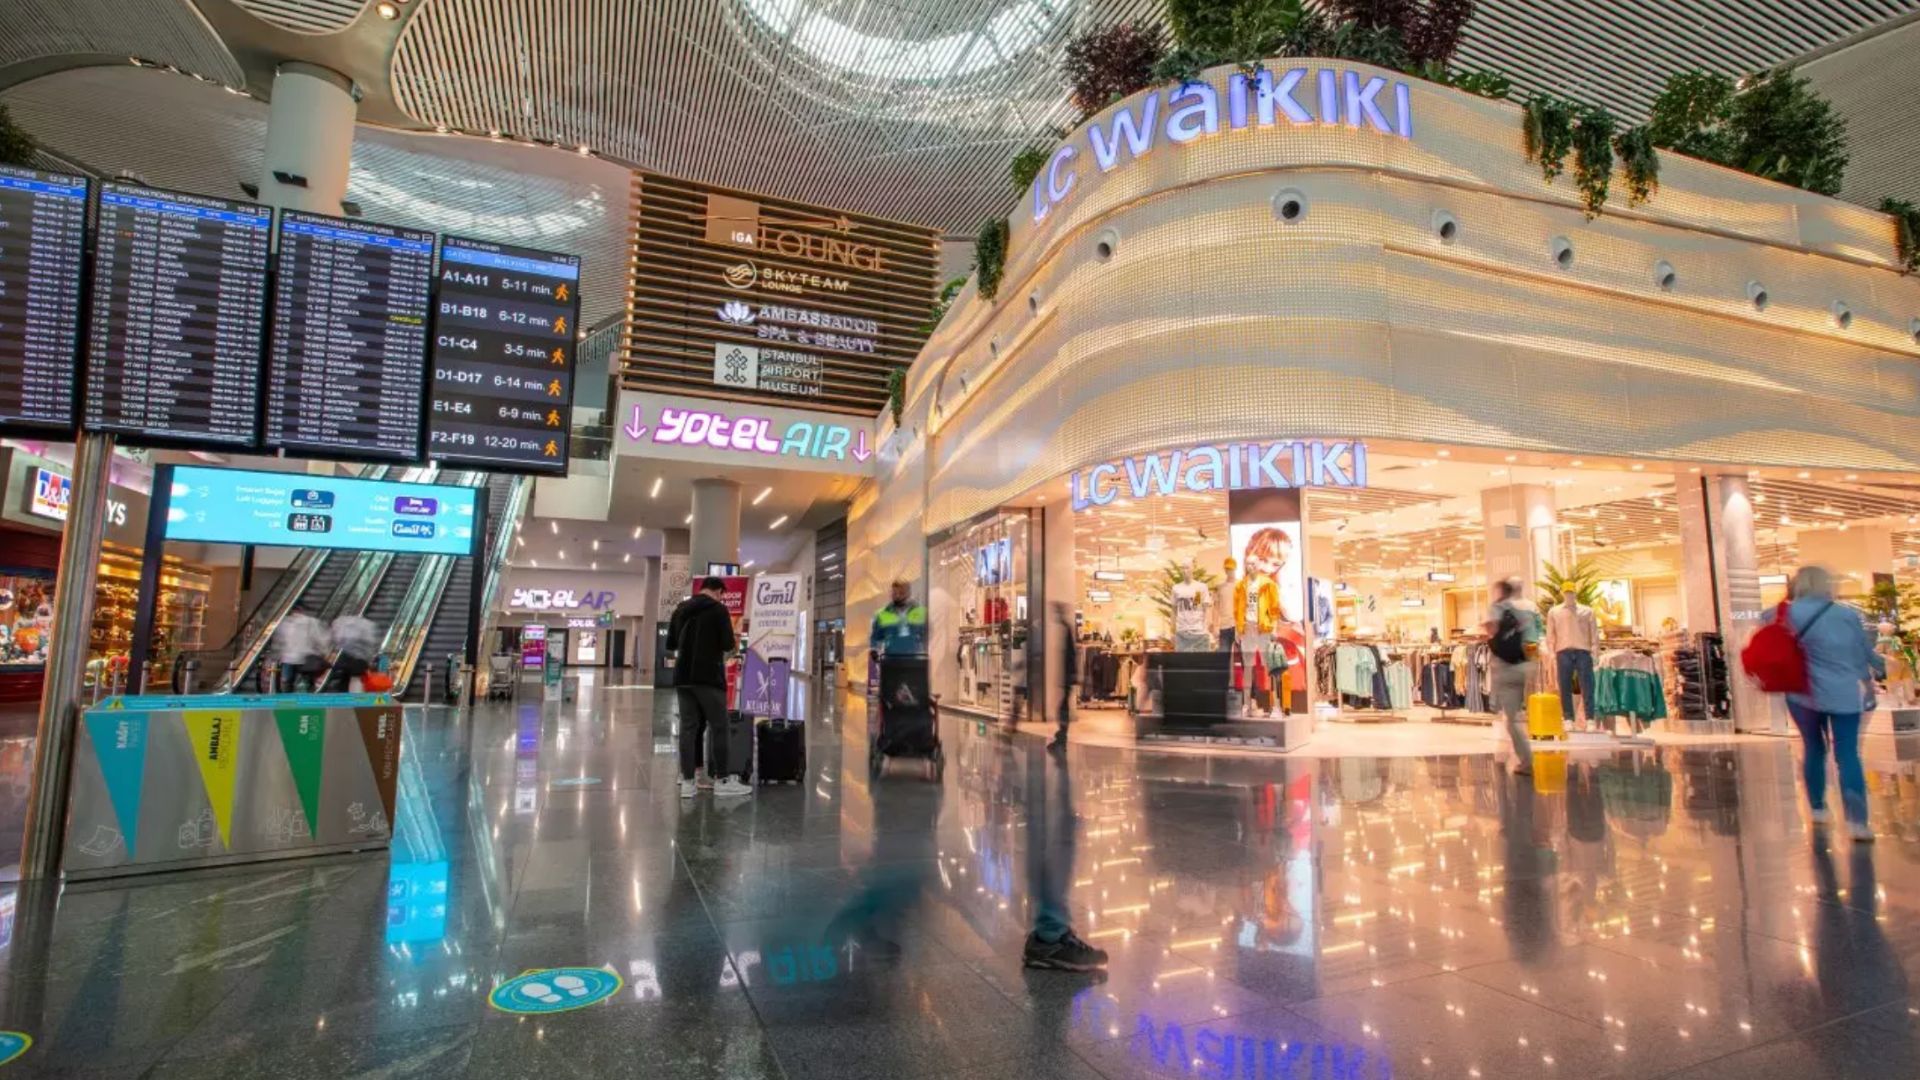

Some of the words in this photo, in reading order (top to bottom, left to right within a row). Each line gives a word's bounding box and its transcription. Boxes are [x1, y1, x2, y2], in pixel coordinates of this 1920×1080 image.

[1032, 145, 1078, 225] LC
[761, 225, 890, 273] LOUNGE
[443, 269, 489, 287] A1-A11
[502, 279, 528, 292] 5-11
[531, 284, 553, 295] min.
[761, 280, 803, 294] LOUNGE
[762, 268, 849, 292] SKYTEAM
[441, 303, 488, 318] B1-B18
[499, 310, 526, 324] 6-12
[529, 316, 550, 327] min.
[758, 305, 879, 336] AMBASSADOR
[438, 336, 478, 351] C1-C4
[504, 344, 524, 356] 3-5
[526, 348, 548, 359] min.
[757, 324, 789, 341] SPA
[797, 331, 809, 344] &
[814, 332, 877, 353] BEAUTY
[435, 369, 482, 384] D1-D17
[494, 375, 521, 388] 6-14
[524, 380, 546, 391] min.
[760, 364, 819, 381] AIRPORT
[759, 380, 819, 396] MUSEUM
[433, 400, 472, 414] E1-E4
[498, 407, 519, 419] 6-9
[522, 410, 544, 421] min.
[431, 431, 475, 445] F2-F19
[484, 436, 517, 449] 12-20
[520, 440, 542, 451] min.
[38, 479, 71, 504] D&R
[1071, 463, 1118, 512] LC
[757, 581, 797, 606] Cemil
[299, 714, 310, 736] CAM
[209, 717, 222, 760] AMBALAJ
